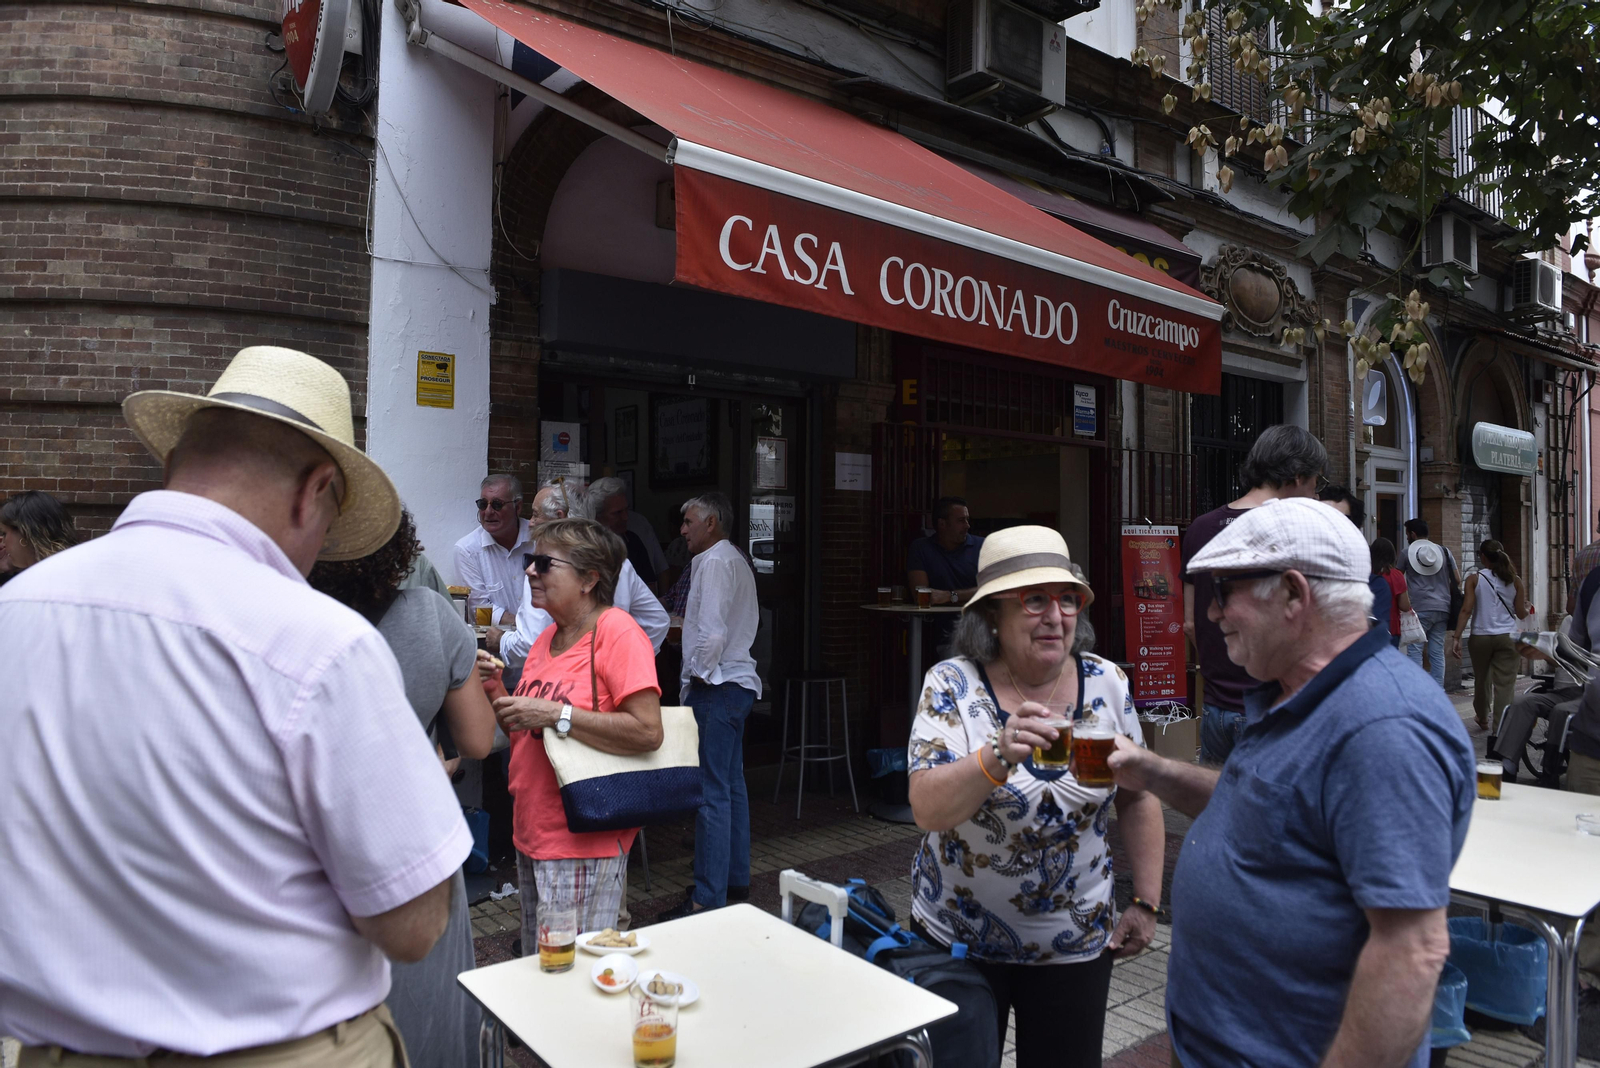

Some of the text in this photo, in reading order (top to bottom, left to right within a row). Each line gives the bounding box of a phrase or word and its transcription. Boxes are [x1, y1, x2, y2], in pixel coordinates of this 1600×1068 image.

[719, 214, 1078, 345] CASA CORONADO
[1107, 299, 1199, 351] Cruzcampo
[1104, 336, 1149, 356] MAESTROS
[420, 354, 451, 362] CONECTADA
[1145, 365, 1164, 378] 1904
[1075, 390, 1089, 398] tyco
[1490, 450, 1522, 468] PLATERIA
[1139, 549, 1161, 560] Sevilla
